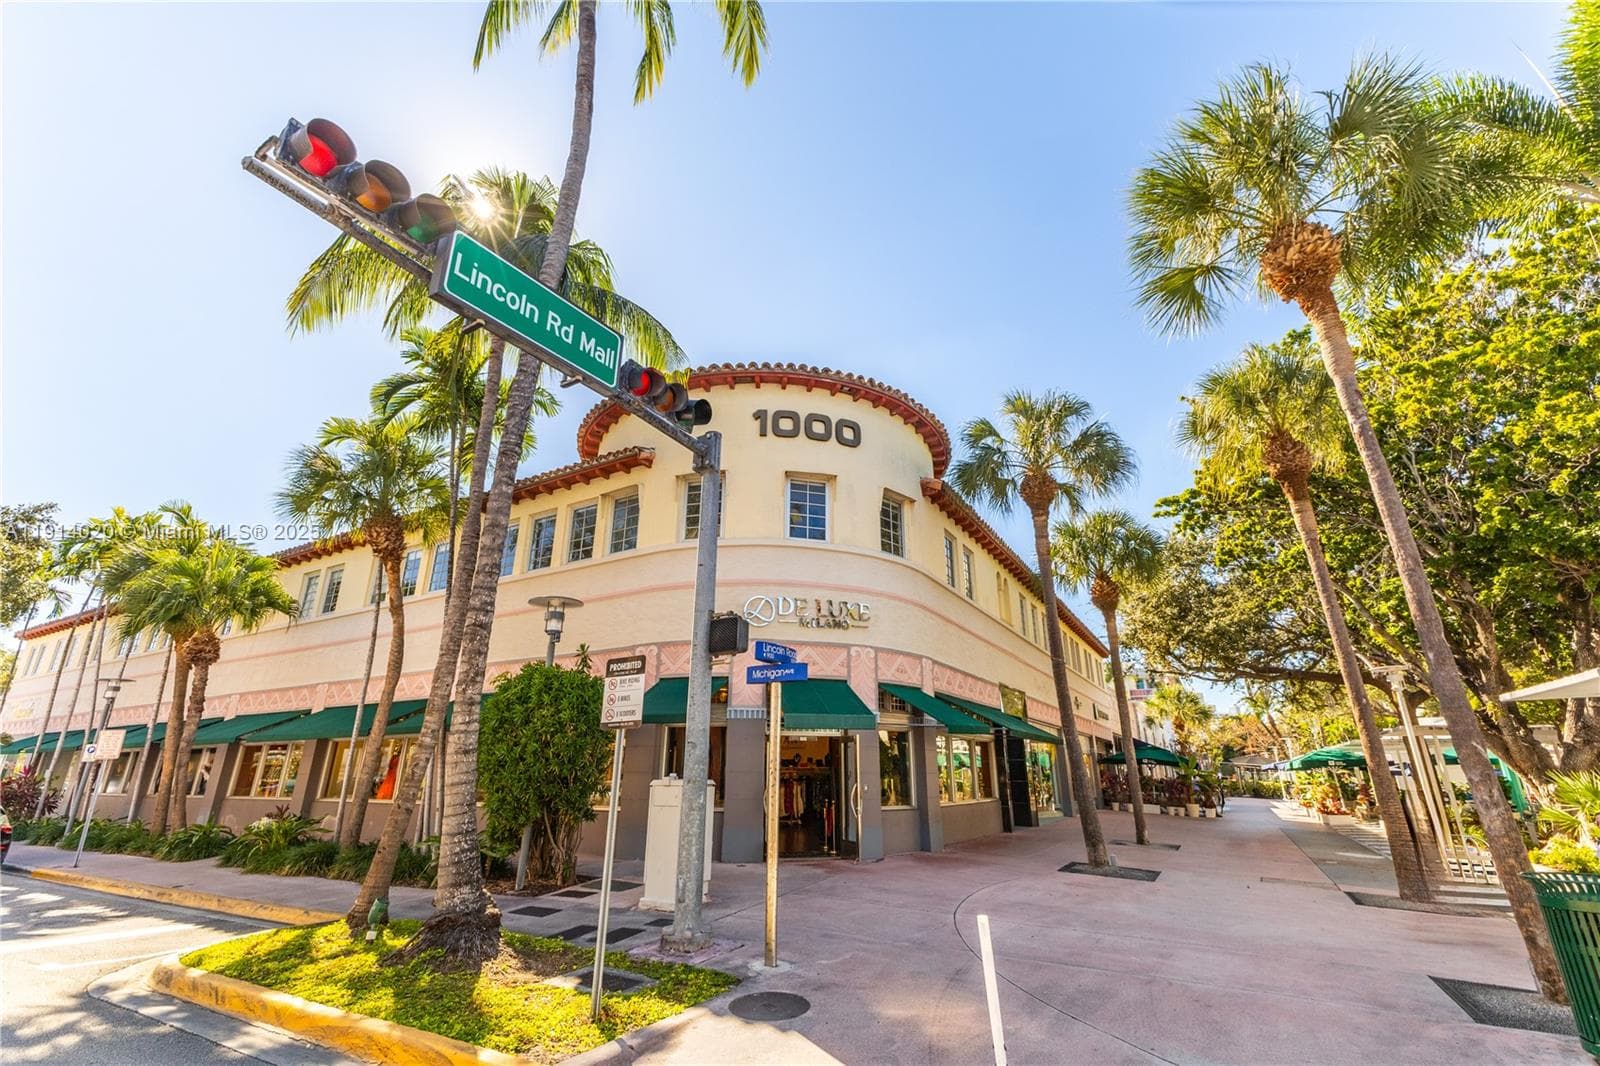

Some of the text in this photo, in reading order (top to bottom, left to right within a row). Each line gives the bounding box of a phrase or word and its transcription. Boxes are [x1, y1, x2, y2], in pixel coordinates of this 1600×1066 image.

[453, 252, 615, 369] Lincoln Rd Mall
[752, 409, 862, 448] 1000
[777, 596, 809, 617] DE
[815, 598, 871, 622] LUXE
[763, 642, 786, 655] Lincoln
[609, 661, 642, 672] PROHIBITED
[752, 668, 785, 680] Michigan
